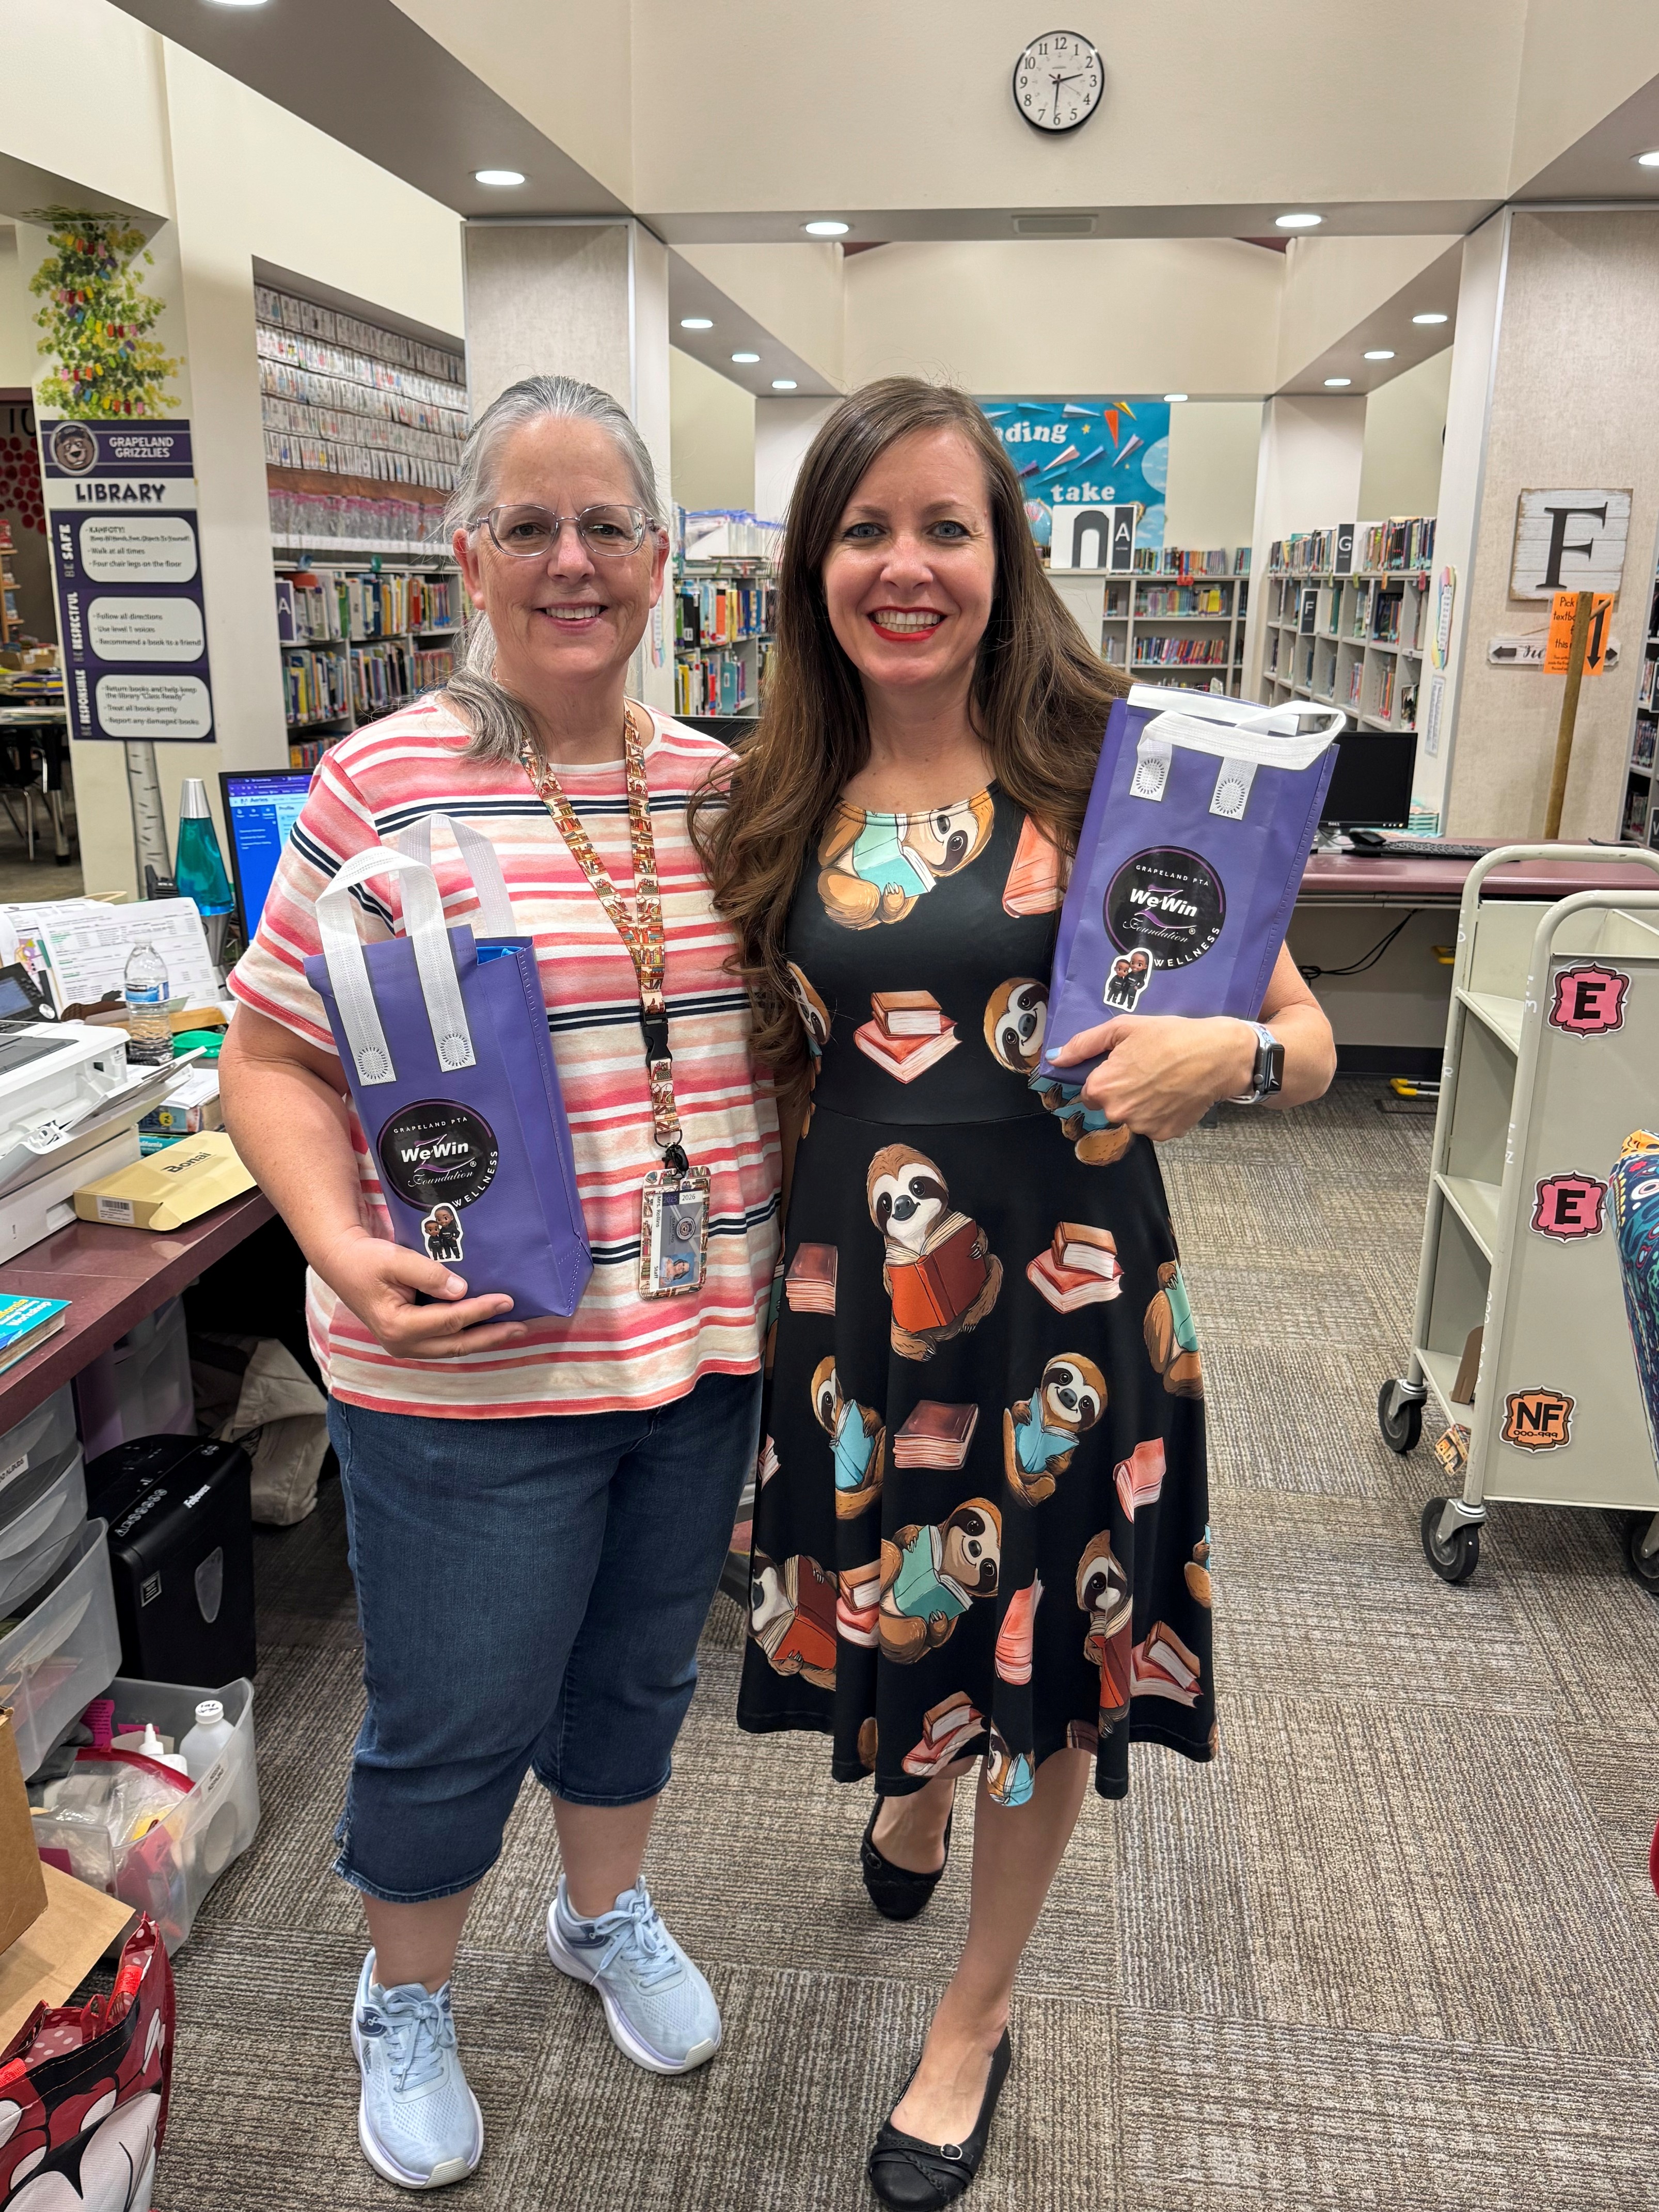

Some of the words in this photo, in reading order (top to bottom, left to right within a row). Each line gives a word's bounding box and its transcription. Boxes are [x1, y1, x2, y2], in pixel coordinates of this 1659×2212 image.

[1038, 43, 1048, 55] 11
[1054, 37, 1067, 50] 12
[1074, 44, 1079, 56] 1
[1024, 57, 1036, 69] 10
[1085, 56, 1094, 68] 2
[1019, 76, 1028, 88] 9
[1089, 75, 1097, 87] 3
[1024, 94, 1032, 106] 8
[1083, 93, 1091, 105] 4
[1038, 109, 1046, 121] 7
[1053, 113, 1061, 125] 6
[1070, 108, 1078, 120] 5
[109, 437, 174, 448] GRAPELAND
[115, 448, 170, 458] GRIZZLIES
[75, 483, 165, 503] LIBRARY
[1051, 482, 1115, 502] take
[1115, 523, 1130, 542] A
[59, 524, 74, 561] SAFE
[1338, 536, 1352, 551] G
[1536, 501, 1608, 589] F
[64, 562, 75, 577] BE
[278, 597, 291, 614] A
[1305, 601, 1315, 614] F
[1560, 597, 1575, 607] Pick
[67, 592, 83, 650] RESPECTFUL
[1555, 639, 1568, 648] this
[75, 669, 91, 724] RESPONSIBLE
[1136, 864, 1188, 881] GRAPELAND
[1193, 878, 1209, 886] PTA
[1129, 888, 1197, 918] WeWin
[1123, 918, 1188, 943] Foundation
[1154, 927, 1220, 967] WELLNESS
[1573, 981, 1606, 1020] E
[393, 1120, 446, 1134] GRAPELAND
[451, 1116, 468, 1125] PTA
[401, 1142, 469, 1163] WeWin
[161, 1152, 212, 1173] Bonai
[407, 1170, 473, 1187] Foundation
[451, 1150, 498, 1208] WELLNESS
[1555, 1189, 1586, 1225] E
[1516, 1401, 1563, 1431] NF
[183, 1484, 211, 1508] Fellowes
